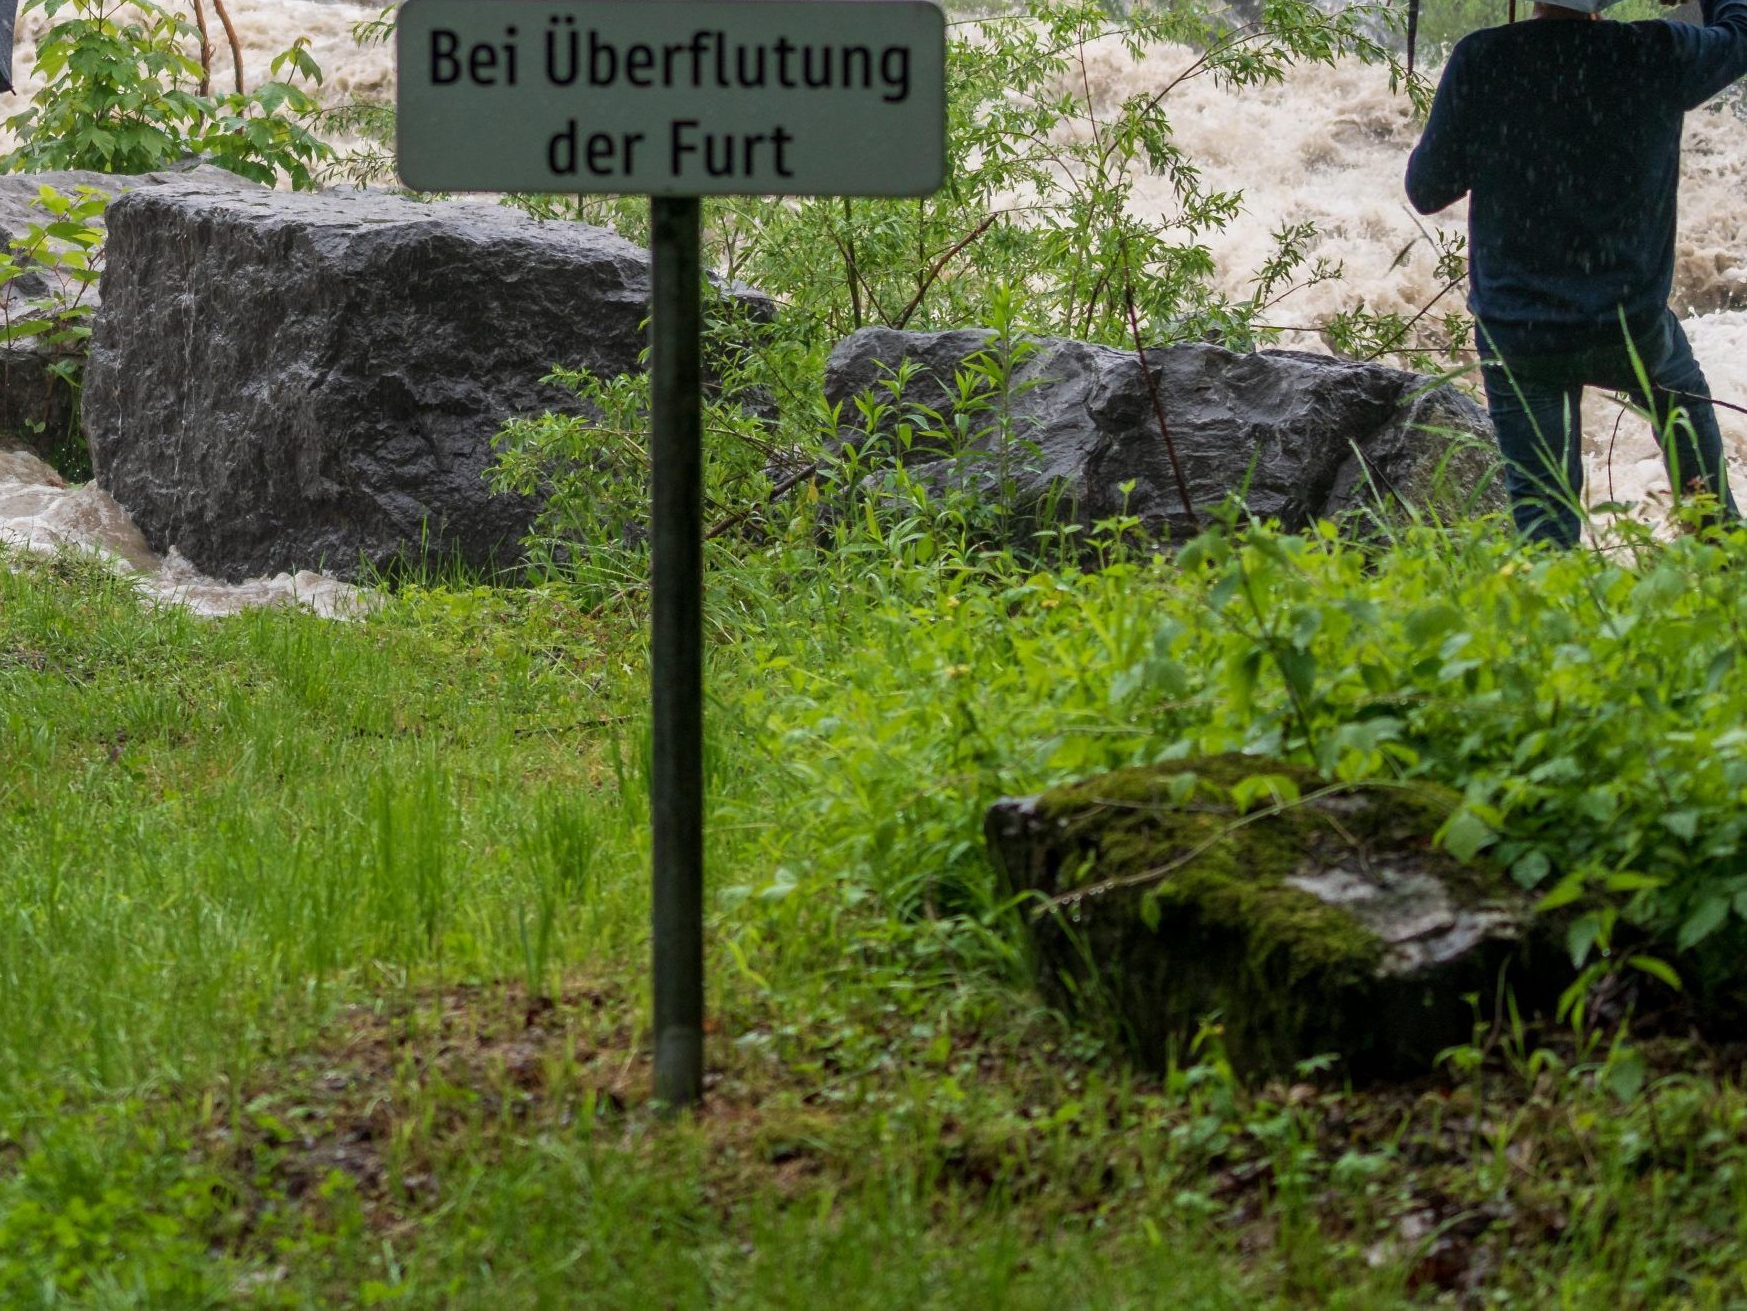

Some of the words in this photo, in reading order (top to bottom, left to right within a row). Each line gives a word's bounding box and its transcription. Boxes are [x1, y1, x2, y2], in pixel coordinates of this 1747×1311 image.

[429, 25, 518, 86] Bei
[544, 15, 912, 103] Überflutung
[546, 119, 645, 177] der
[670, 120, 794, 178] Furt
